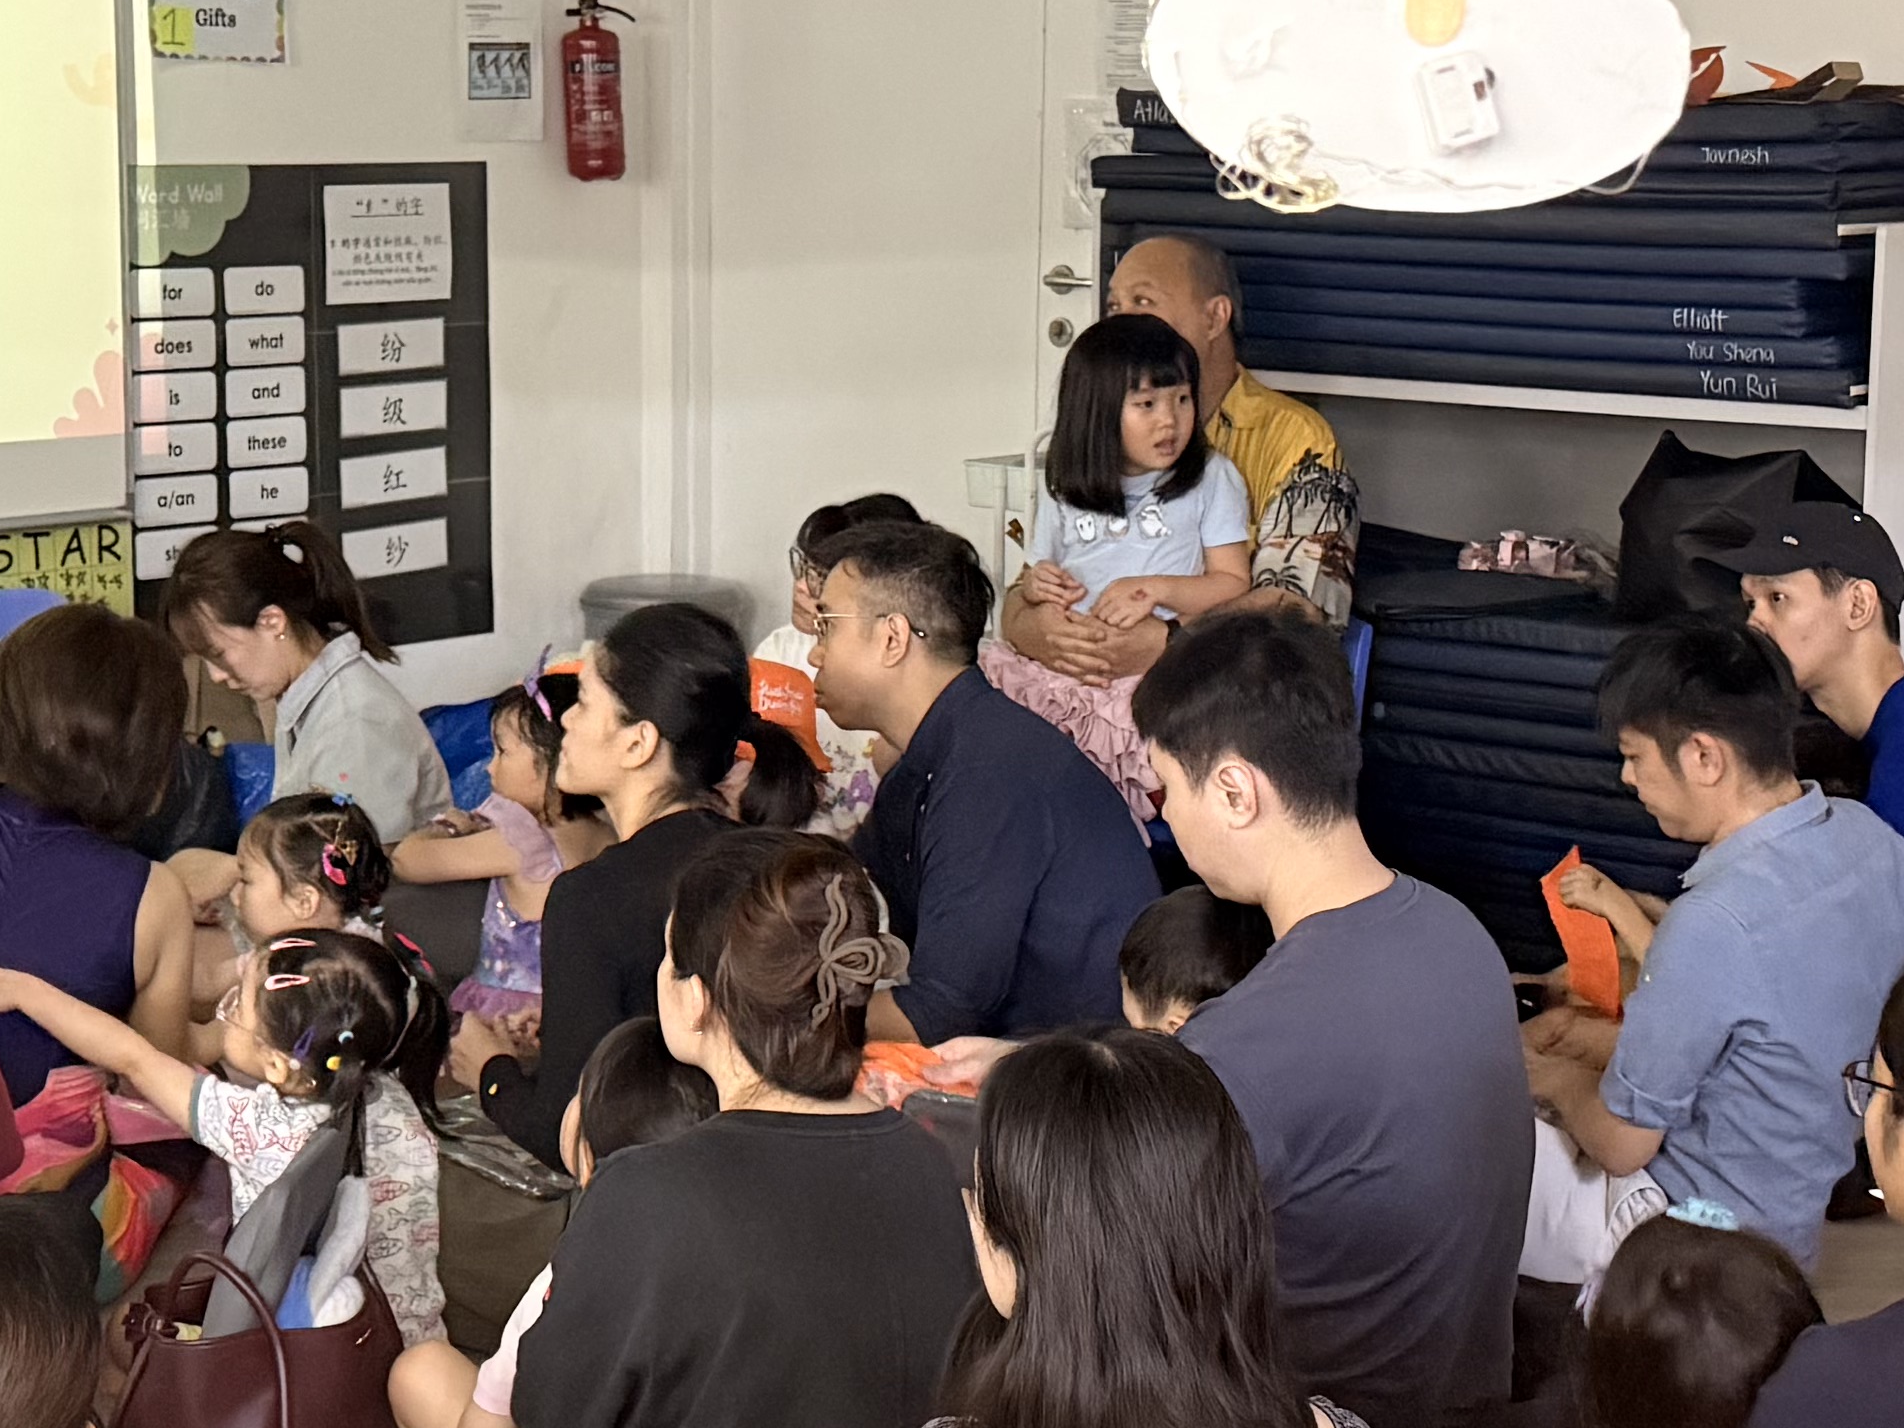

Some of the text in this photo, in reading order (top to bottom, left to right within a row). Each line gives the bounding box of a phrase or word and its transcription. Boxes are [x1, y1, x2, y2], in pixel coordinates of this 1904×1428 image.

[162, 8, 186, 46] 1
[196, 8, 237, 29] Gifts
[187, 181, 224, 203] Wall
[162, 284, 183, 300] for
[254, 281, 275, 297] do
[154, 337, 193, 354] does
[248, 333, 284, 350] what
[380, 332, 406, 364] 纷
[251, 382, 281, 400] and
[1700, 369, 1778, 400] Yun Rui
[169, 389, 181, 406] is
[382, 397, 408, 427] 级
[168, 440, 184, 458] to
[247, 433, 288, 452] these
[382, 464, 408, 491] 红
[157, 490, 196, 510] a/an
[260, 483, 280, 501] he
